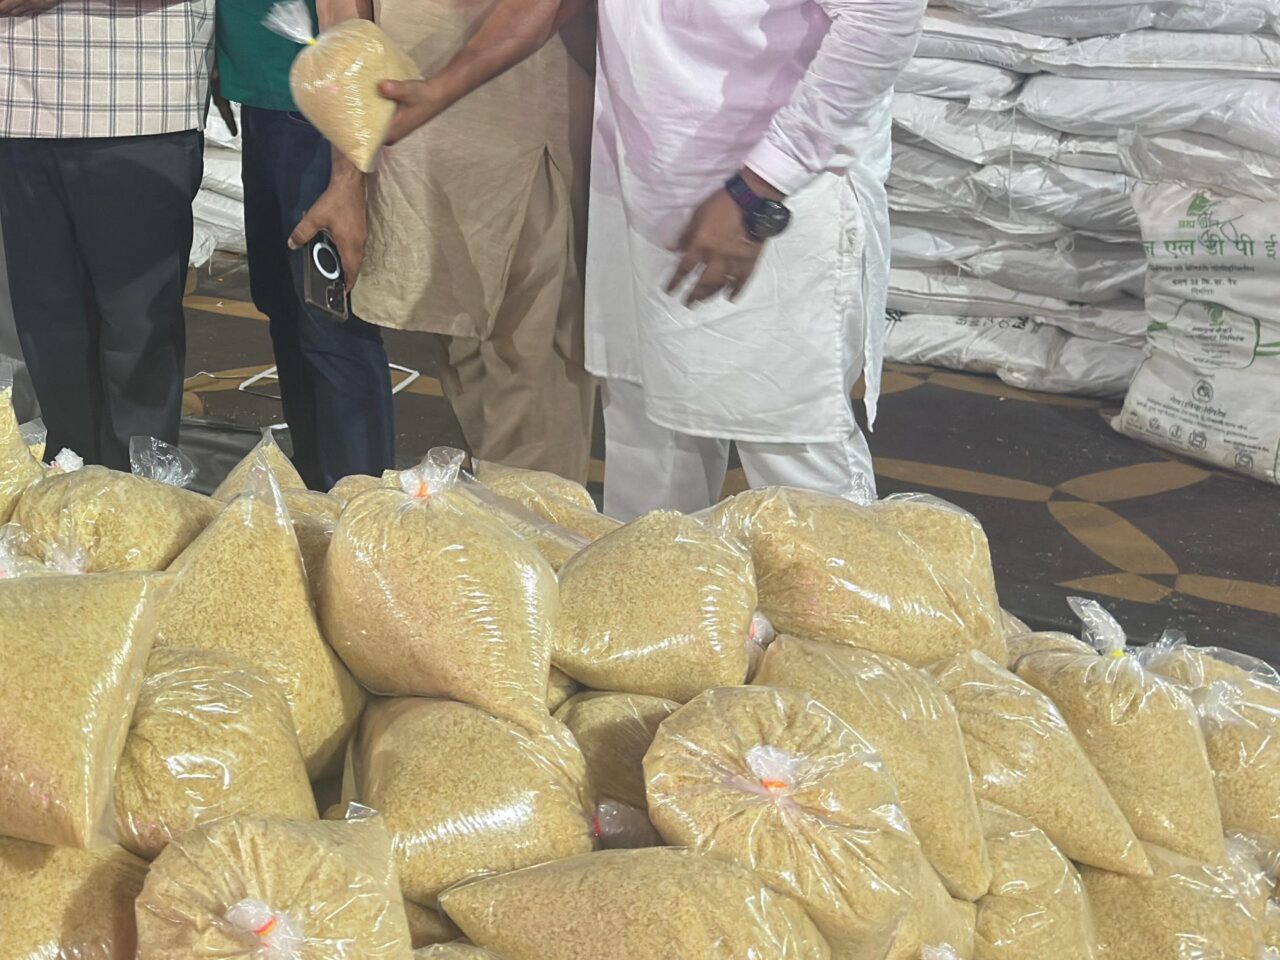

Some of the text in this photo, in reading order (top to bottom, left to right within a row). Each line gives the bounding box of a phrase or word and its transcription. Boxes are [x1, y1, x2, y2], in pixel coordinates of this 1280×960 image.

[1163, 239, 1196, 258] एल
[1232, 233, 1256, 256] पी
[1264, 233, 1278, 260] ई
